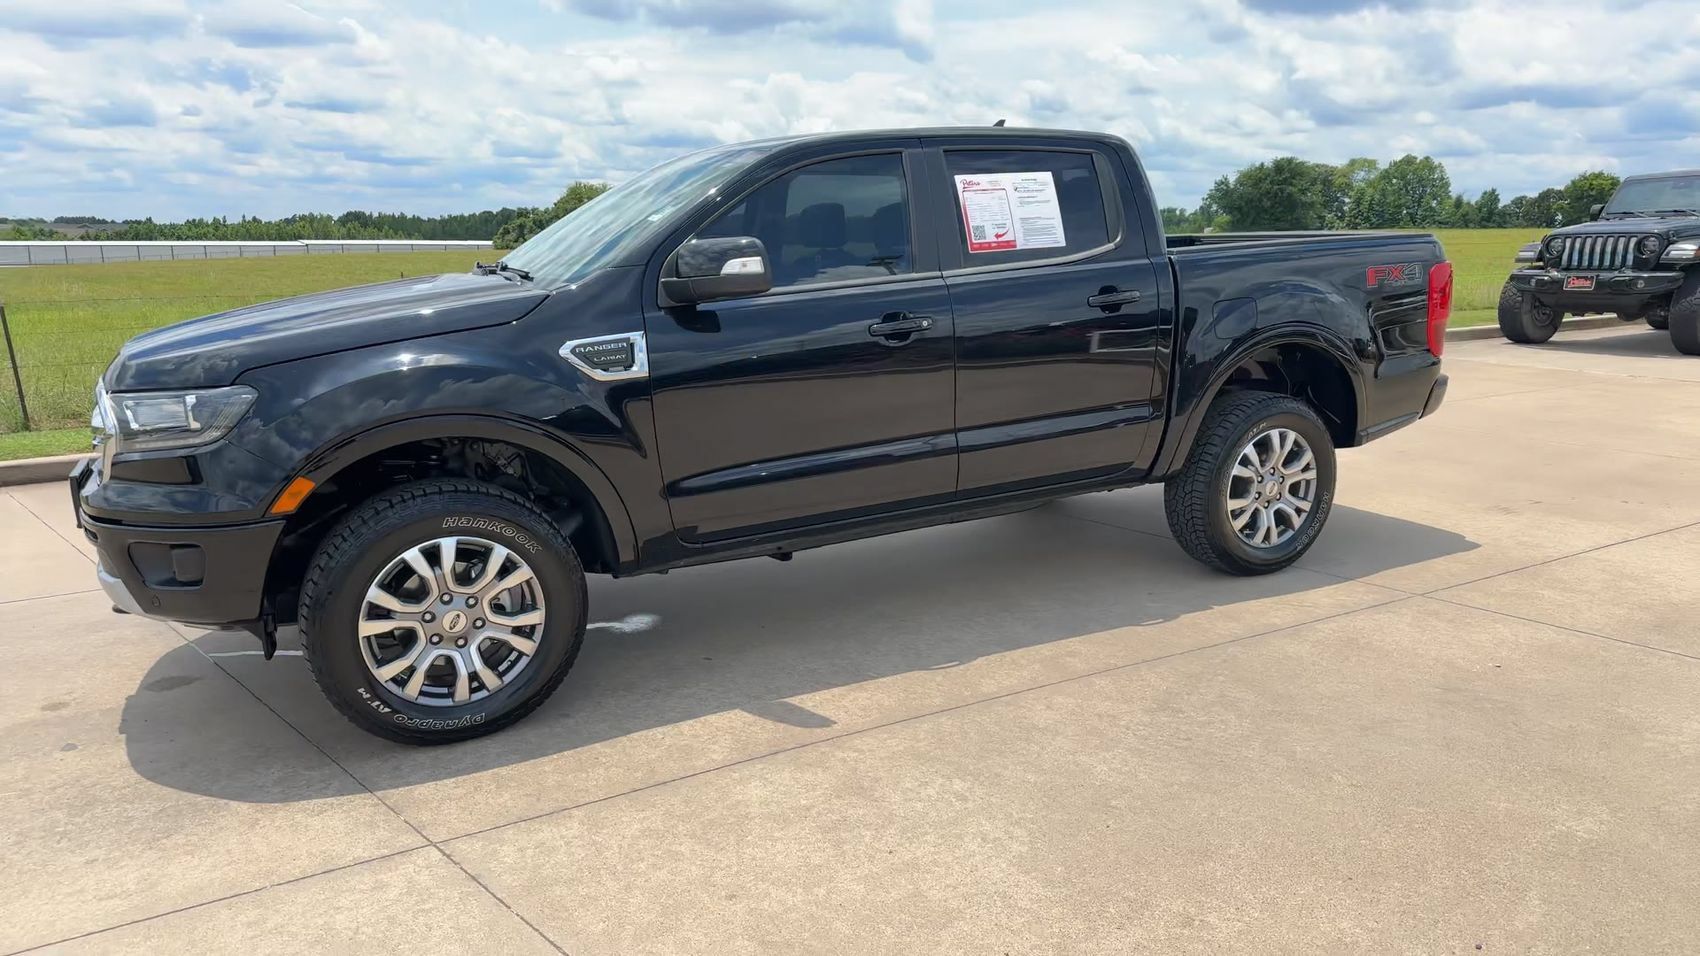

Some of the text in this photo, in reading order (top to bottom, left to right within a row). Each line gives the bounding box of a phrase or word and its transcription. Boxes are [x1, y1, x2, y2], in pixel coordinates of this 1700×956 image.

[1366, 262, 1423, 288] FX4
[575, 342, 627, 353] RANGER
[594, 354, 627, 362] LARIAT
[393, 712, 486, 729] Dynapro
